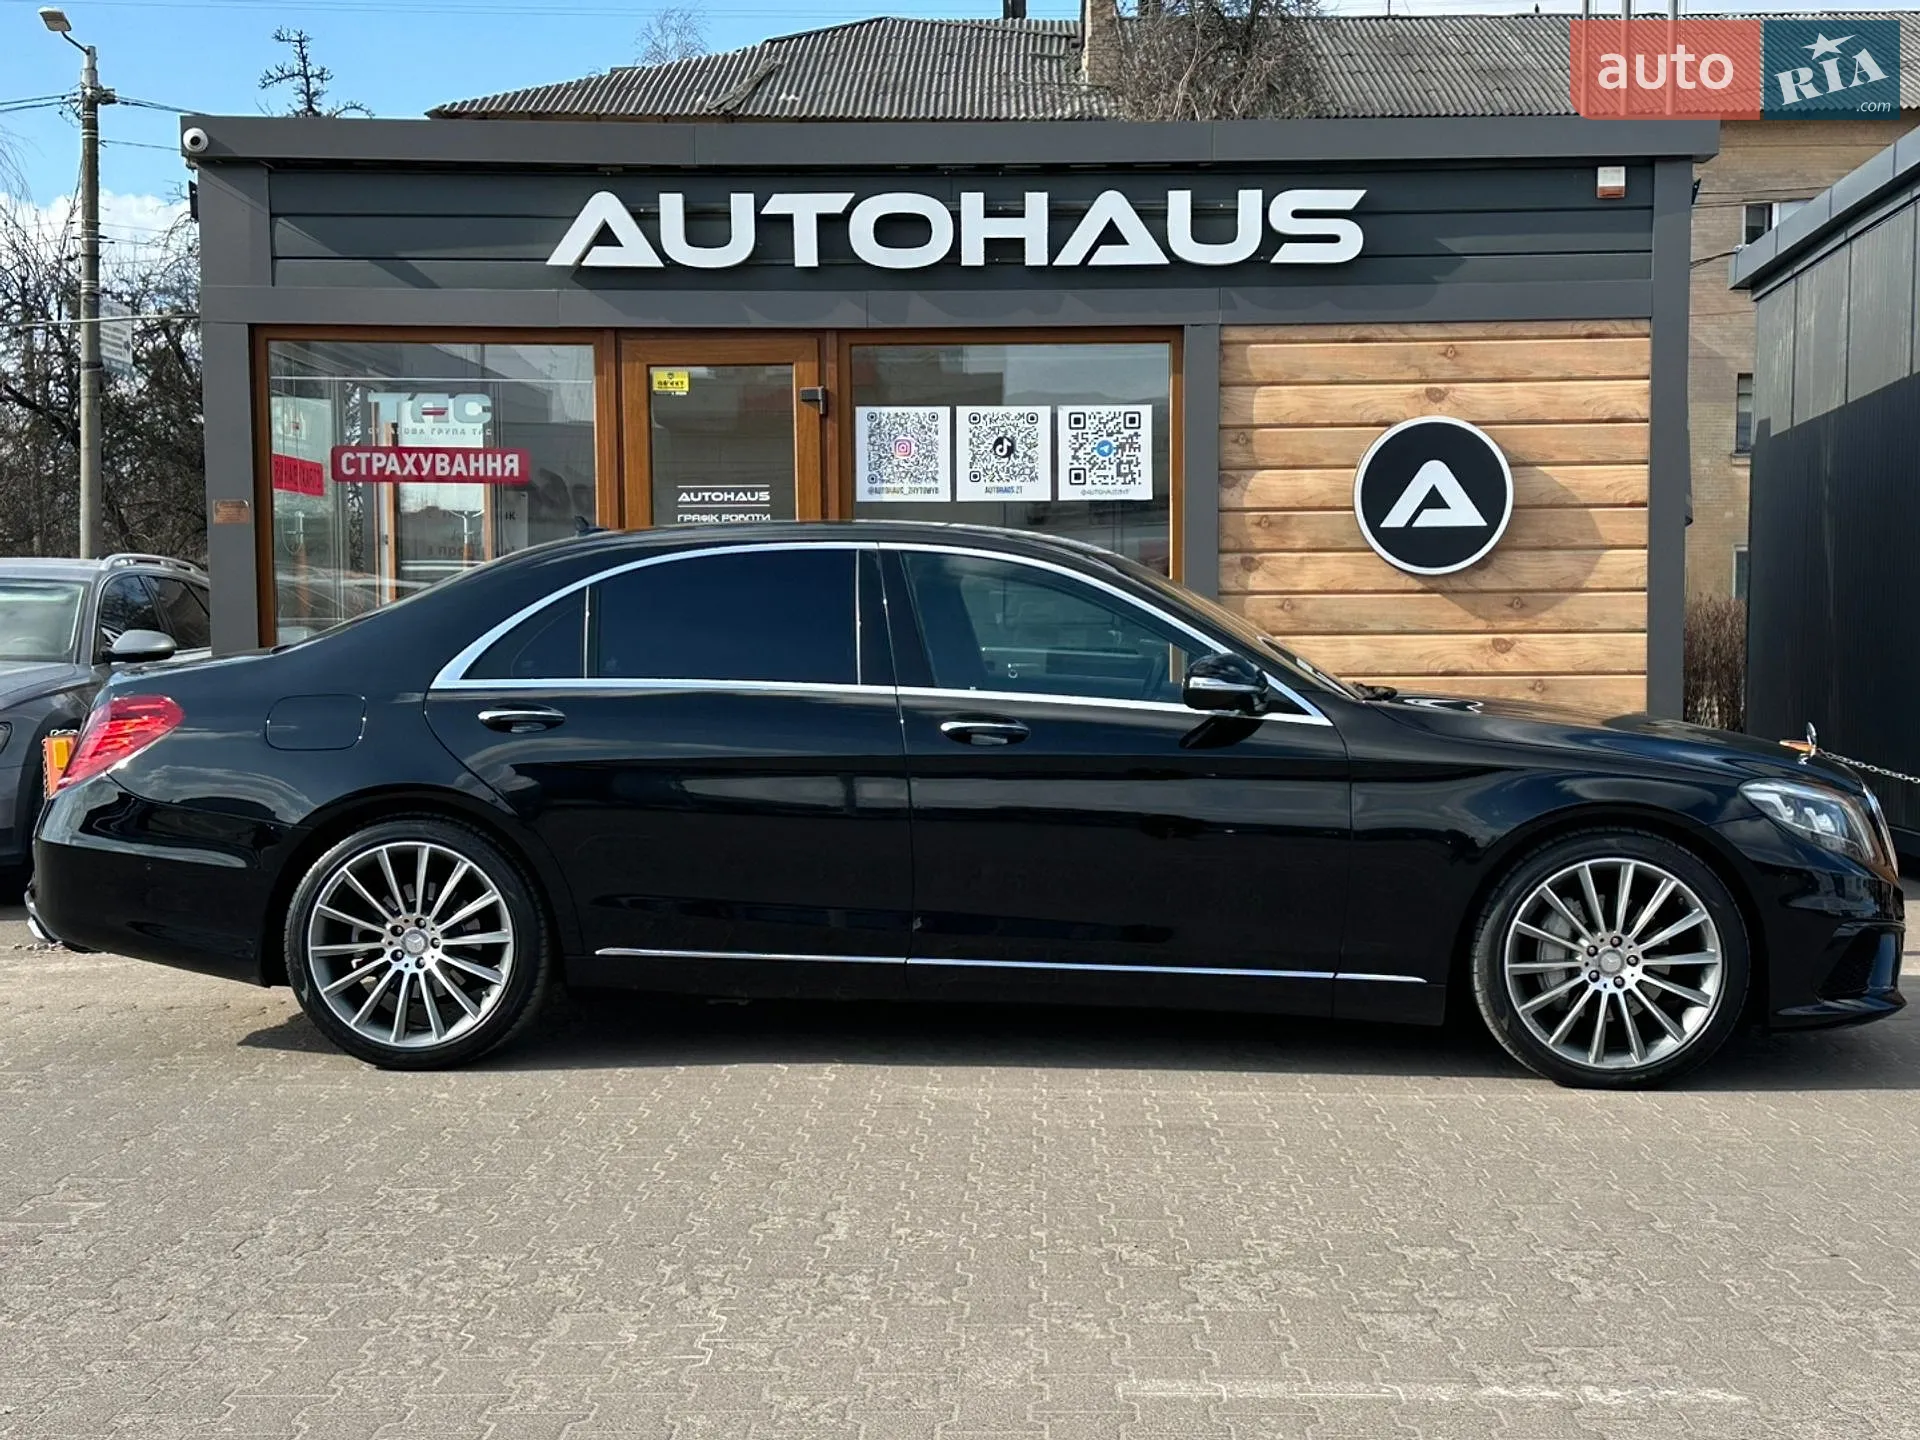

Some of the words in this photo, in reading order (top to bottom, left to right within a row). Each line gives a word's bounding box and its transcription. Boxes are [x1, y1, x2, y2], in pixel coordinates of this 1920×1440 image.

[545, 189, 1367, 269] AUTOHAUS
[341, 452, 520, 477] СТРАХУВАННЯ
[677, 491, 770, 502] AUTOHAUS
